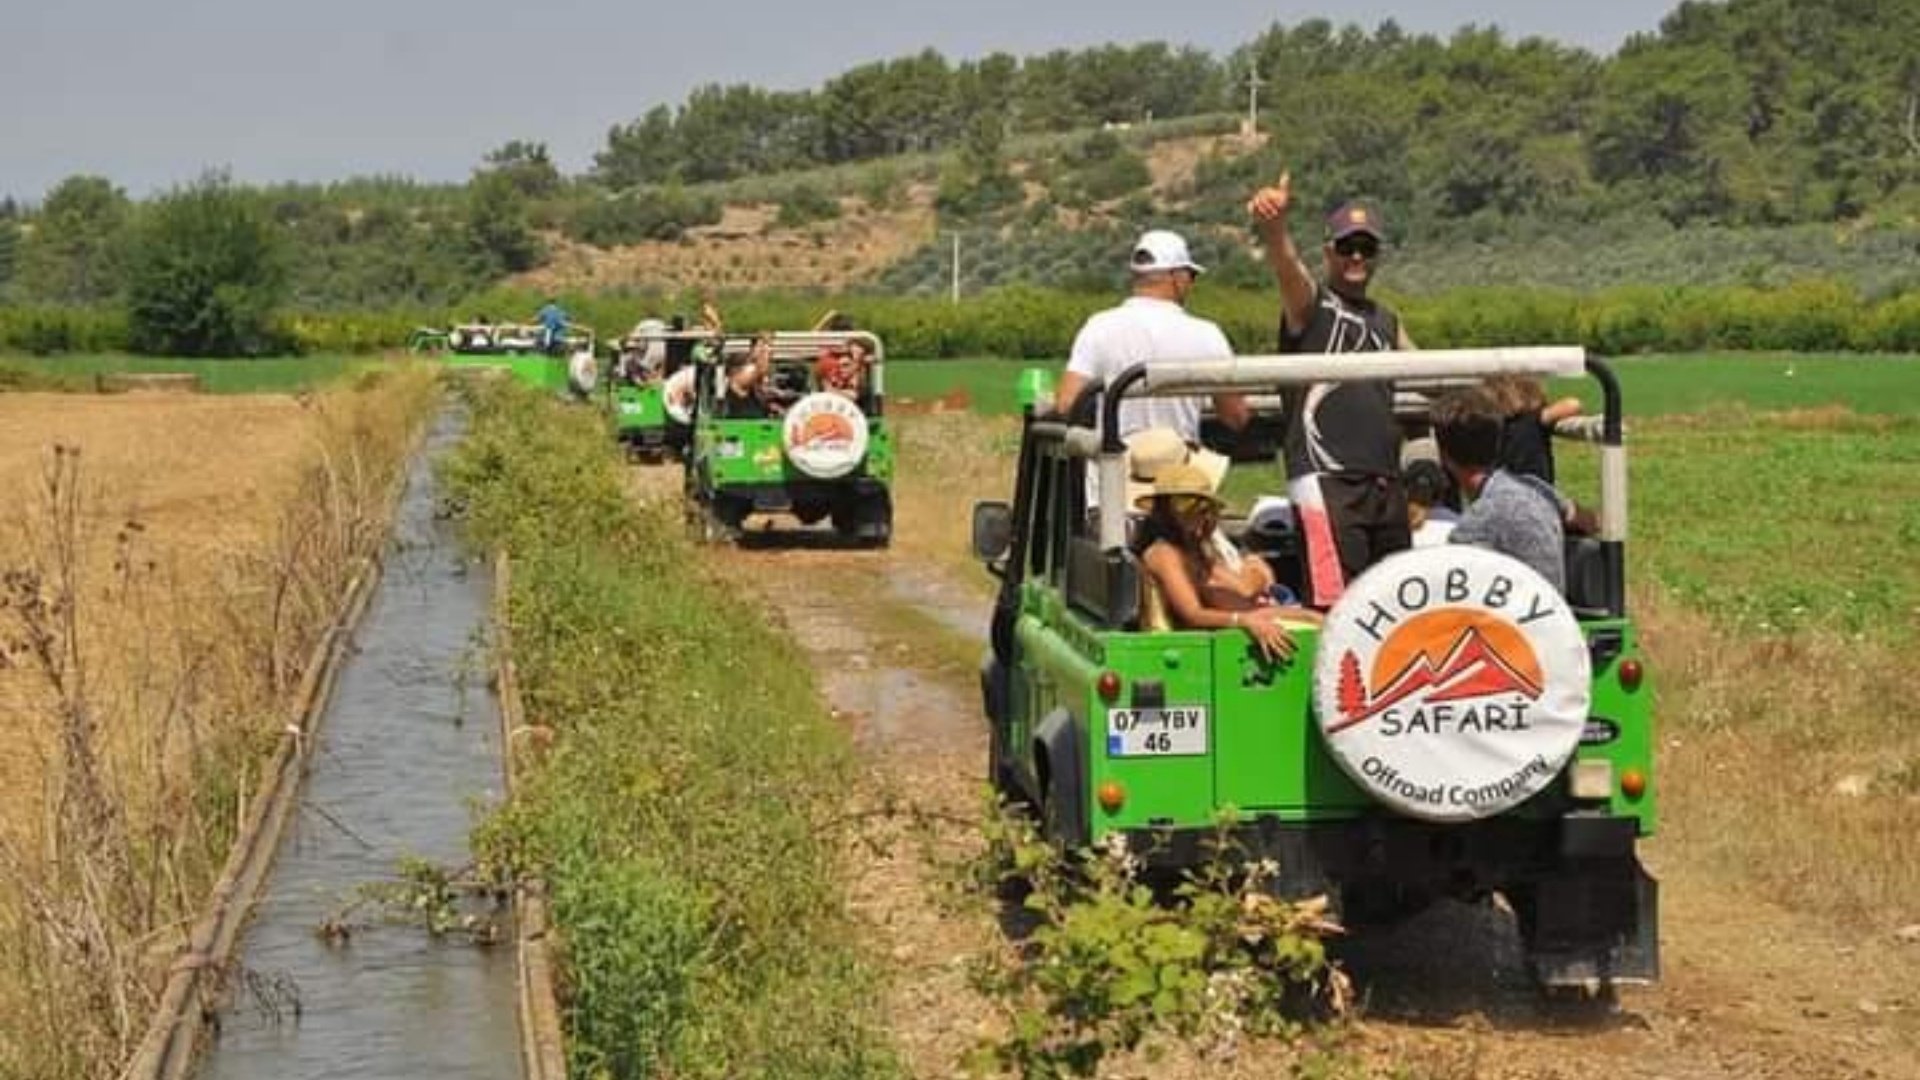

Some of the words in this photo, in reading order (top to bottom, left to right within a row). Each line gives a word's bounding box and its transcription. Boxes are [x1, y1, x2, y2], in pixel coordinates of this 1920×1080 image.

[1355, 568, 1554, 641] HOBBY
[1114, 710, 1142, 731] 07
[1159, 710, 1199, 729] YBV
[1379, 696, 1531, 736] SAFARİ
[1143, 732, 1172, 752] 46
[1361, 757, 1444, 804] Offroad
[1449, 754, 1548, 804] Company
